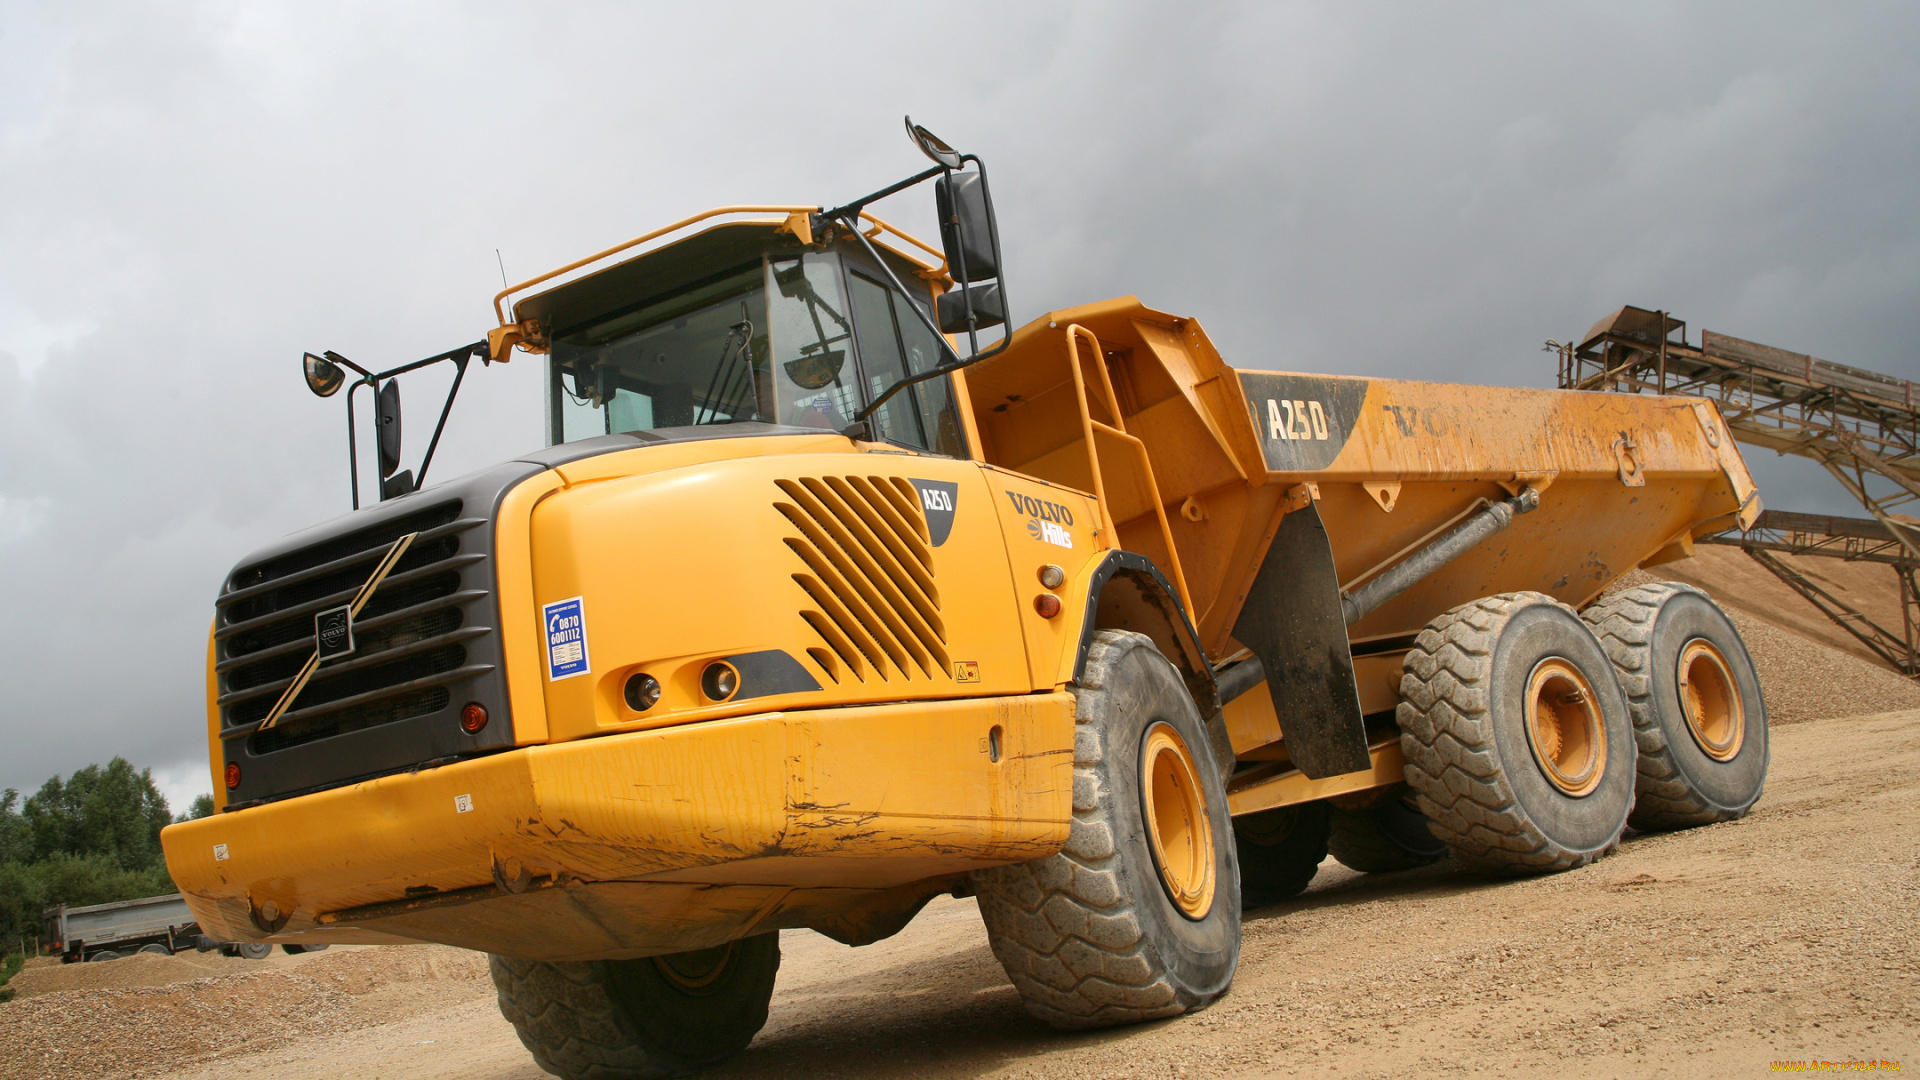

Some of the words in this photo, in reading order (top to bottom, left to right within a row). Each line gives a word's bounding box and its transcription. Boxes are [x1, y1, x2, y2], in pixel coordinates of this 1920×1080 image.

[1267, 399, 1328, 440] A25D
[1005, 490, 1074, 526] VOLVO
[1040, 521, 1073, 549] Hills
[322, 627, 345, 638] VOLVO
[559, 615, 579, 630] 0870
[551, 628, 580, 645] 6001112
